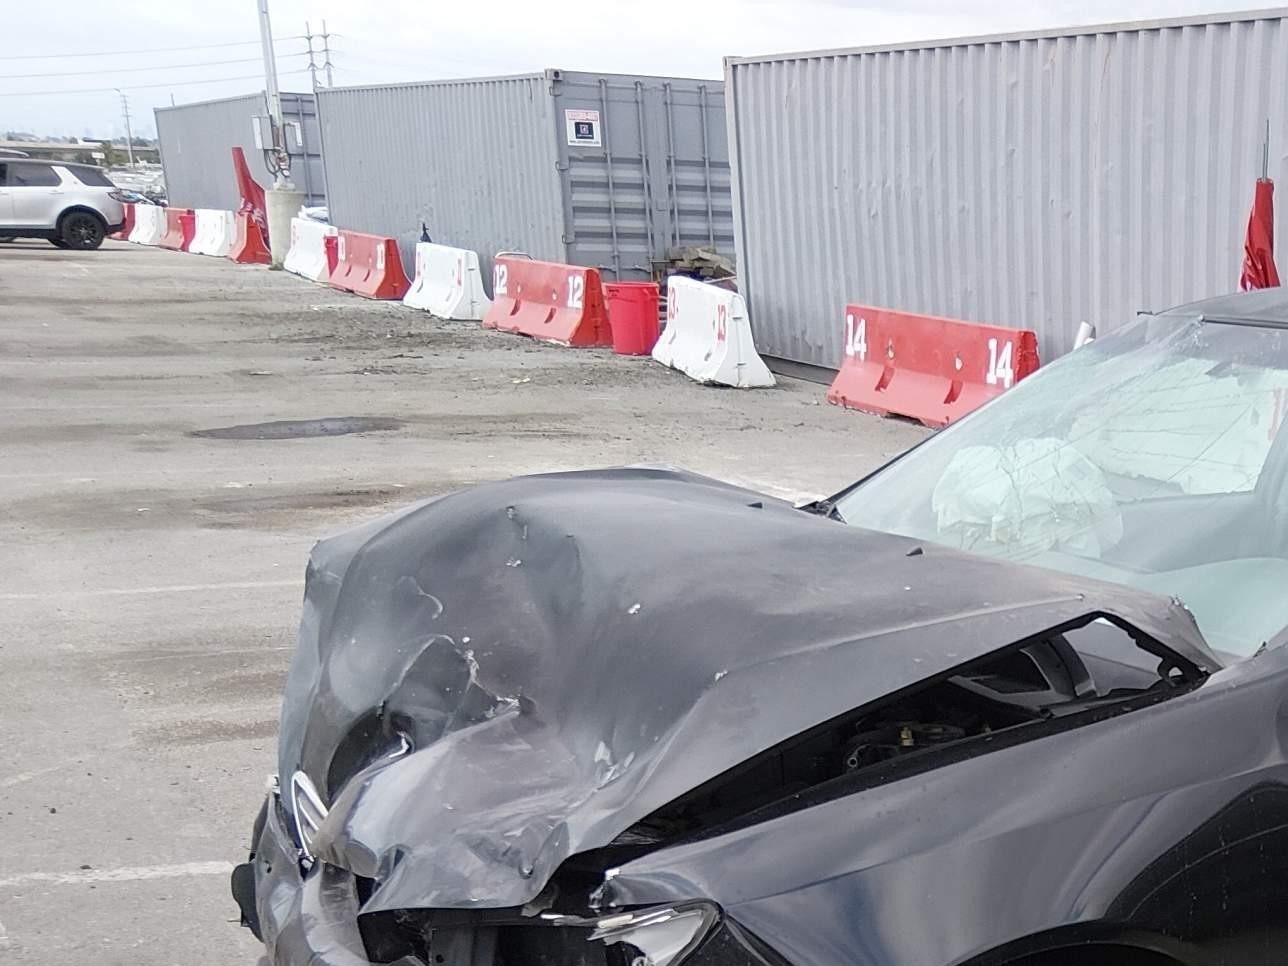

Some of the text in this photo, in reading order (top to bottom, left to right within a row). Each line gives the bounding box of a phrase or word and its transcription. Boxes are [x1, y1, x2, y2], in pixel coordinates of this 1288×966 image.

[495, 264, 508, 294] 12
[567, 275, 584, 309] 12
[717, 304, 727, 342] 13
[846, 314, 867, 361] 14
[986, 337, 1014, 389] 14
